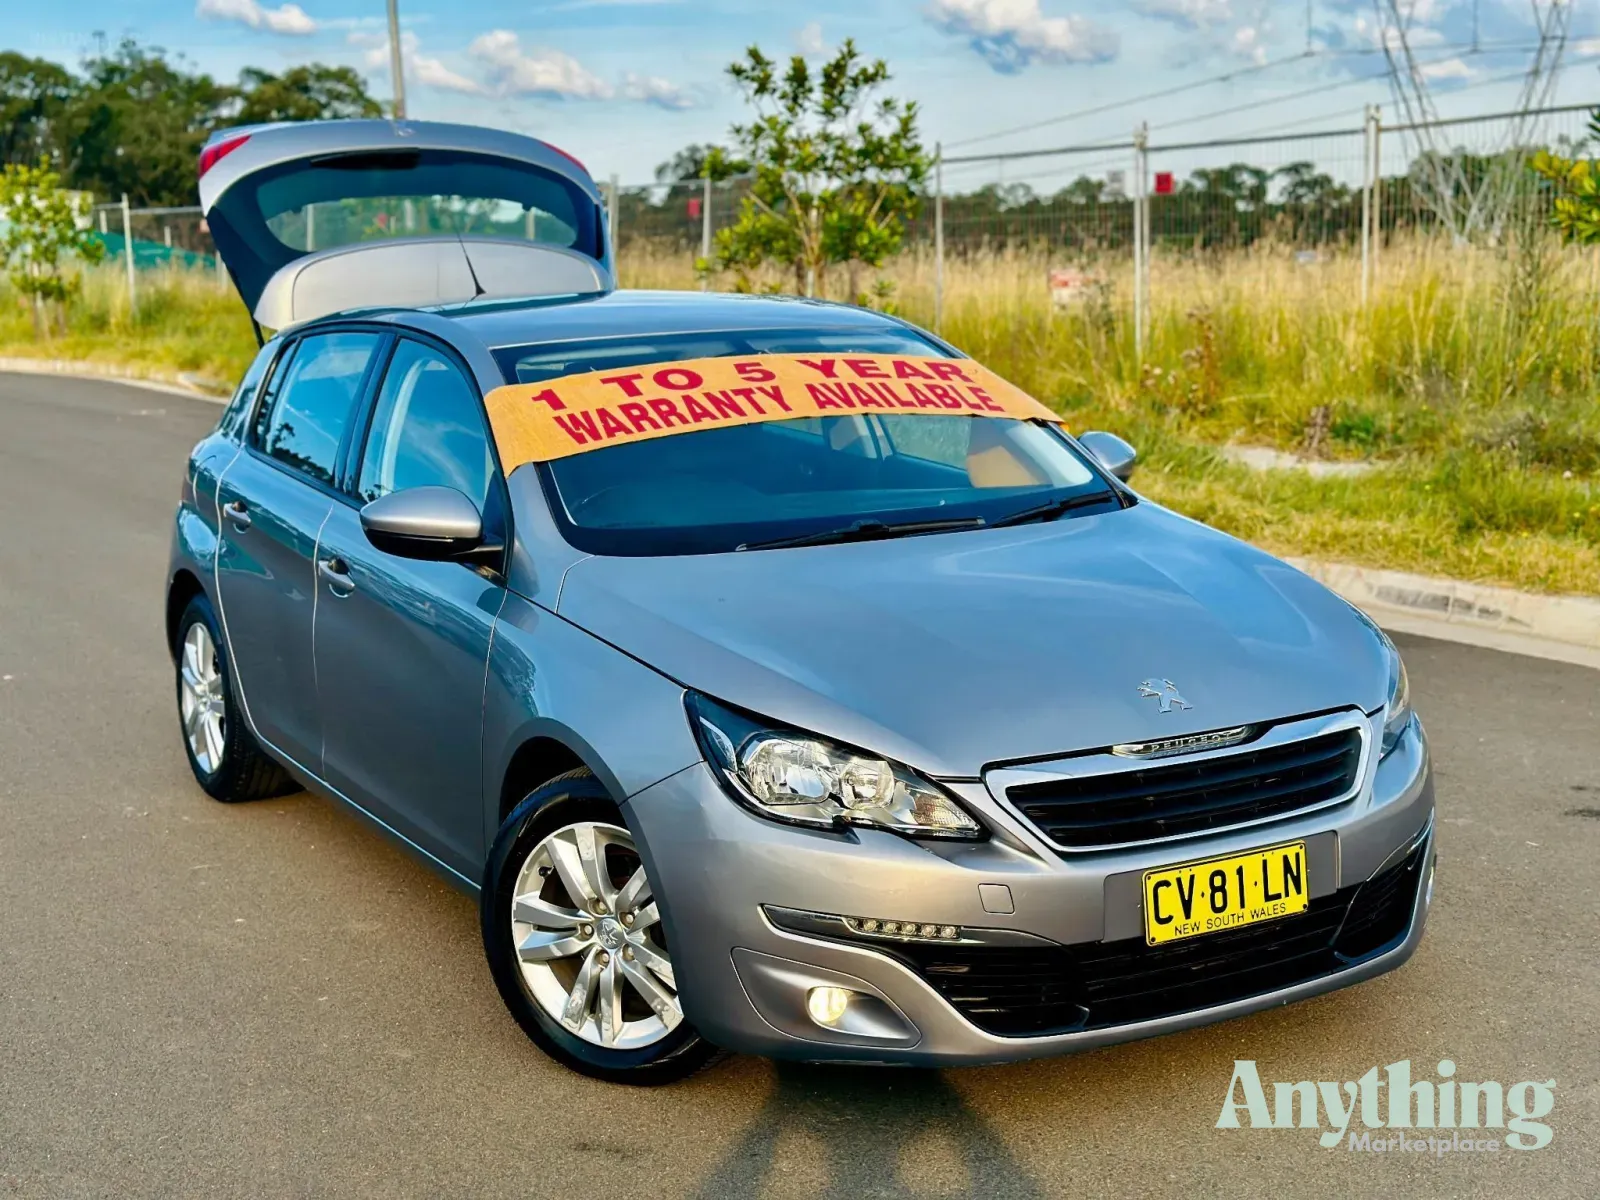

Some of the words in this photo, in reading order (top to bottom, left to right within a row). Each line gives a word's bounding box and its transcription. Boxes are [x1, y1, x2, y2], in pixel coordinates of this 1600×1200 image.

[531, 388, 567, 412] 1
[599, 368, 703, 398] TO
[734, 362, 777, 383] 5
[798, 359, 973, 383] YEAR
[552, 387, 792, 445] WARRANTY
[804, 382, 1003, 412] AVAILABLE
[1174, 920, 1201, 936] NEW
[1206, 911, 1245, 930] SOUTH
[1250, 902, 1287, 920] WALES
